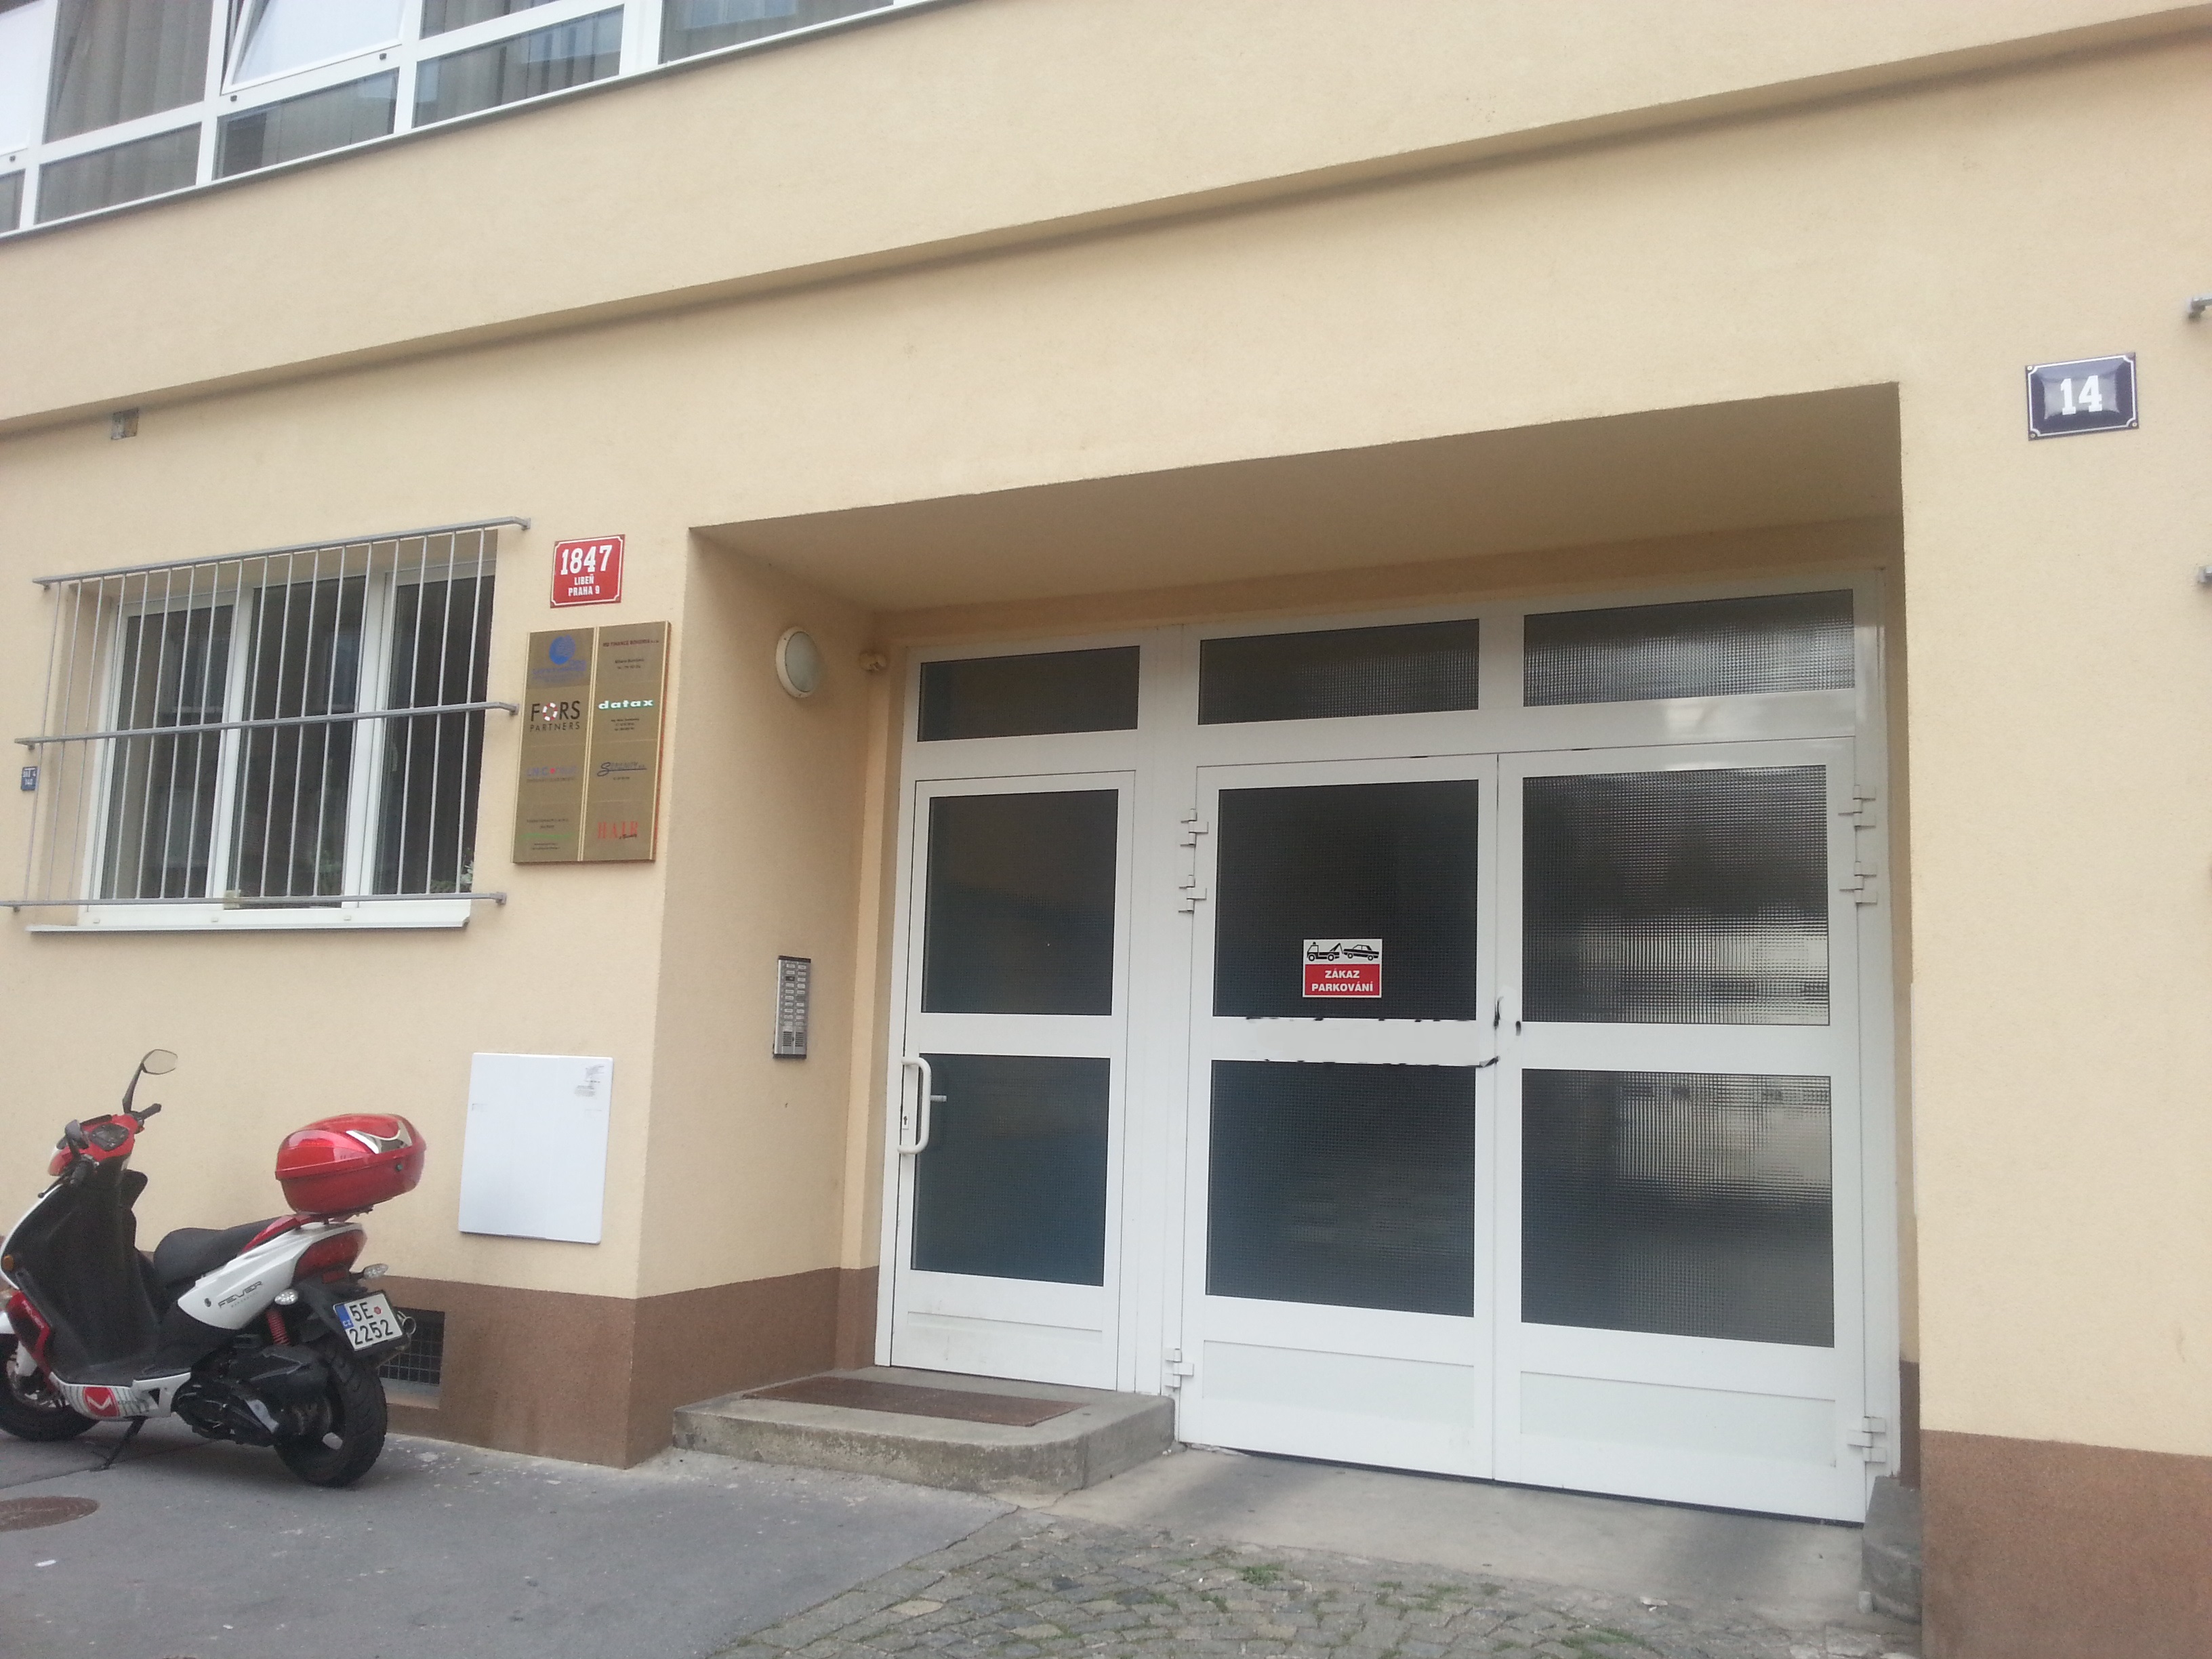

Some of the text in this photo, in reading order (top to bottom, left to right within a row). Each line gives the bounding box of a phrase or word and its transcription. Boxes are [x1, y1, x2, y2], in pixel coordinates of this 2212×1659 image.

[2060, 375, 2102, 415] 14
[560, 545, 613, 575] 1847
[568, 586, 600, 596] PRAHA 9
[598, 699, 653, 710] datax
[529, 721, 580, 732] PARTNERS
[1324, 968, 1360, 979] ZÁKAZ
[1311, 981, 1374, 991] PARKOVÁNÍ
[349, 1302, 374, 1322] 5E
[349, 1319, 393, 1345] 2252
